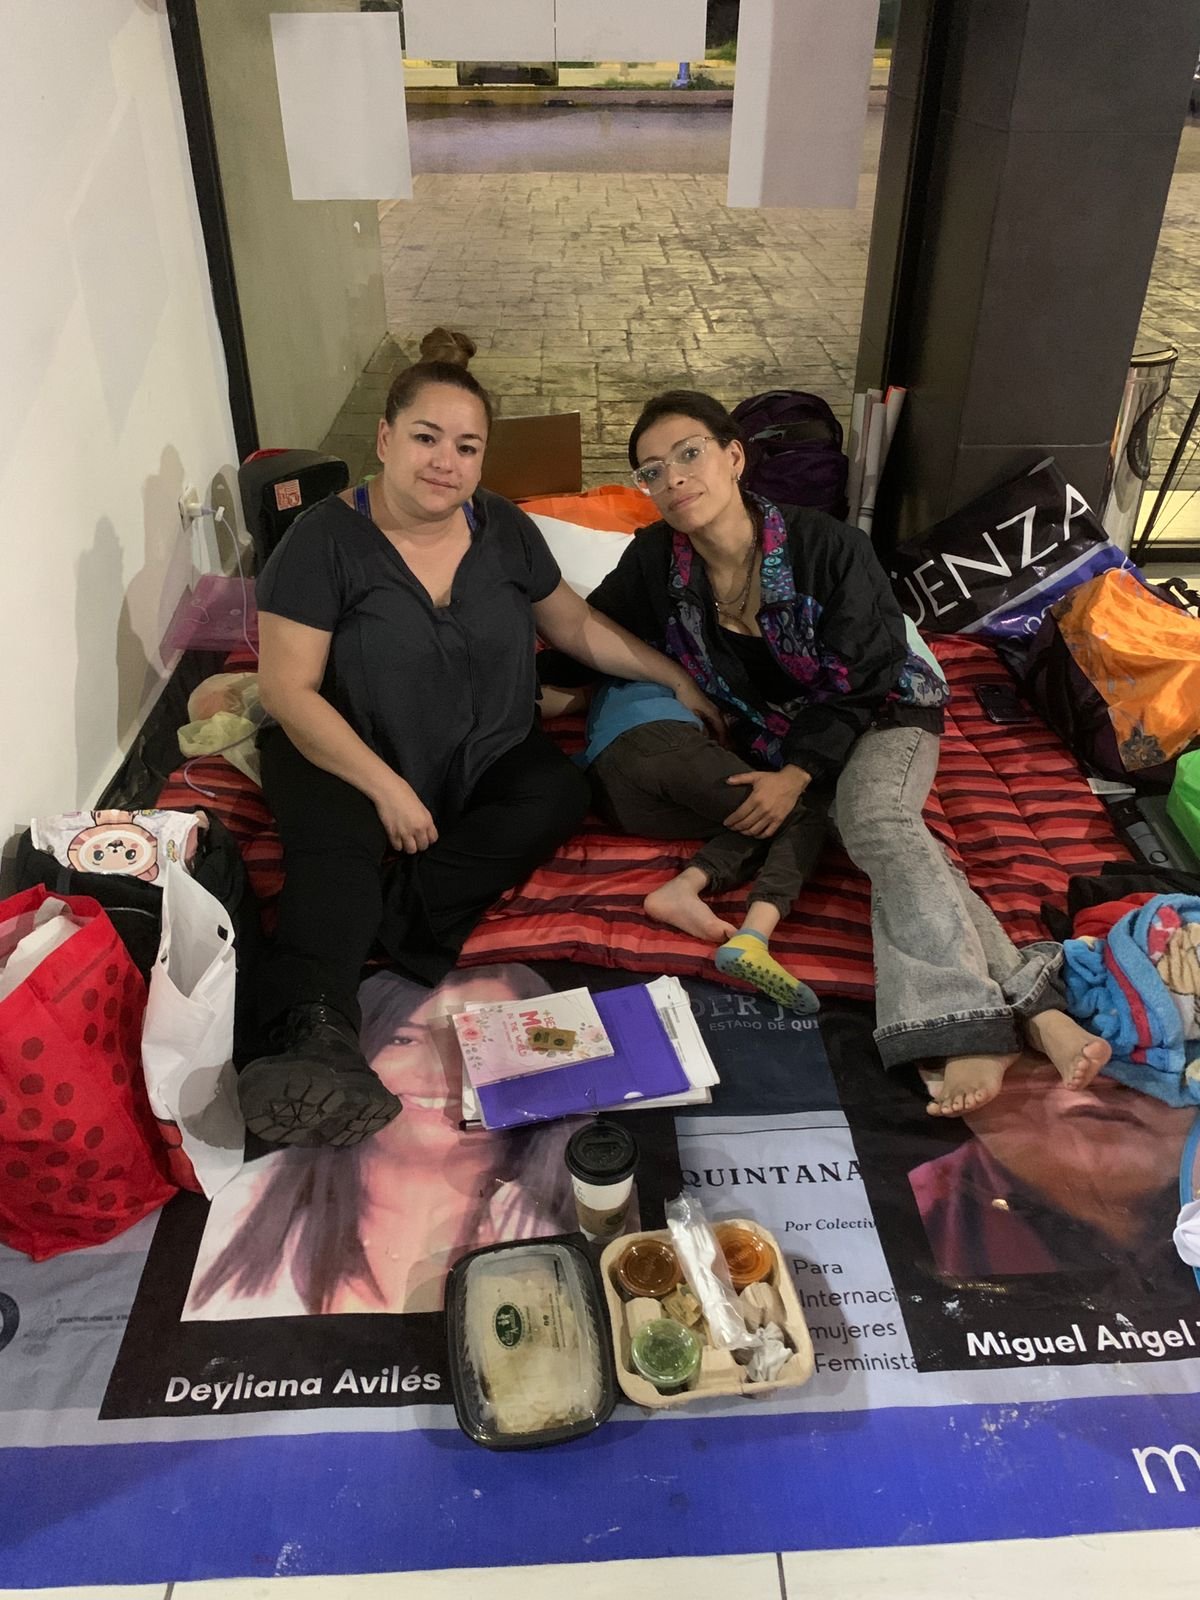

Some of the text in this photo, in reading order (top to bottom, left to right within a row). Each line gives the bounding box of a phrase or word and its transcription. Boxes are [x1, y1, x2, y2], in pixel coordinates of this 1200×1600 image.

[709, 1020, 762, 1031] ESTADO
[767, 1021, 785, 1031] DE
[681, 1160, 863, 1188] QUINTANA
[784, 1220, 812, 1232] Por
[792, 1259, 843, 1275] Para
[808, 1322, 897, 1345] mujeres
[966, 1319, 1196, 1362] Miguel Angel
[165, 1365, 441, 1410] Deyliana Avilés
